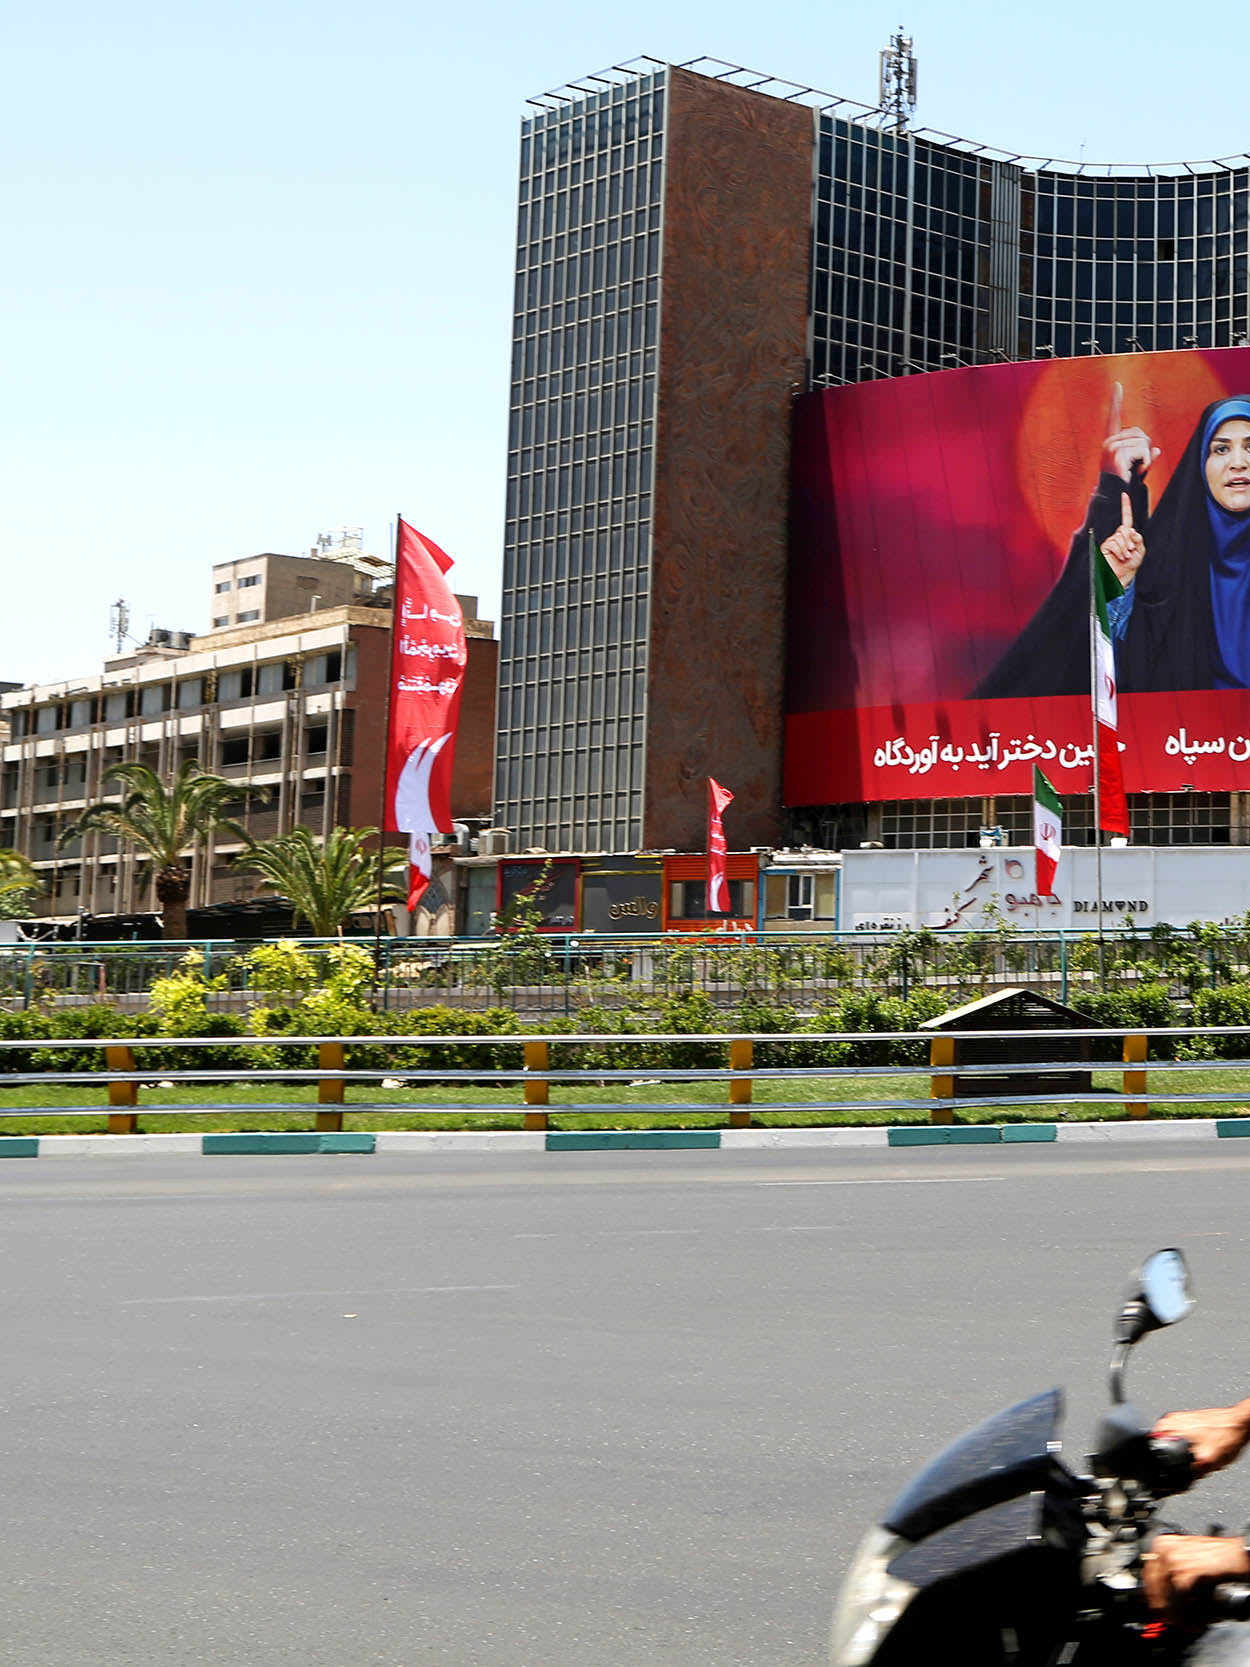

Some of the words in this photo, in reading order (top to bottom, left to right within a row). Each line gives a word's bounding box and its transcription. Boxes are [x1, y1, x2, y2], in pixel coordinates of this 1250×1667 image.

[873, 735, 940, 775] آوردگاه
[940, 742, 964, 770] به
[964, 732, 1001, 770] آید
[997, 735, 1055, 770] دختر
[1164, 728, 1226, 765] سپاه
